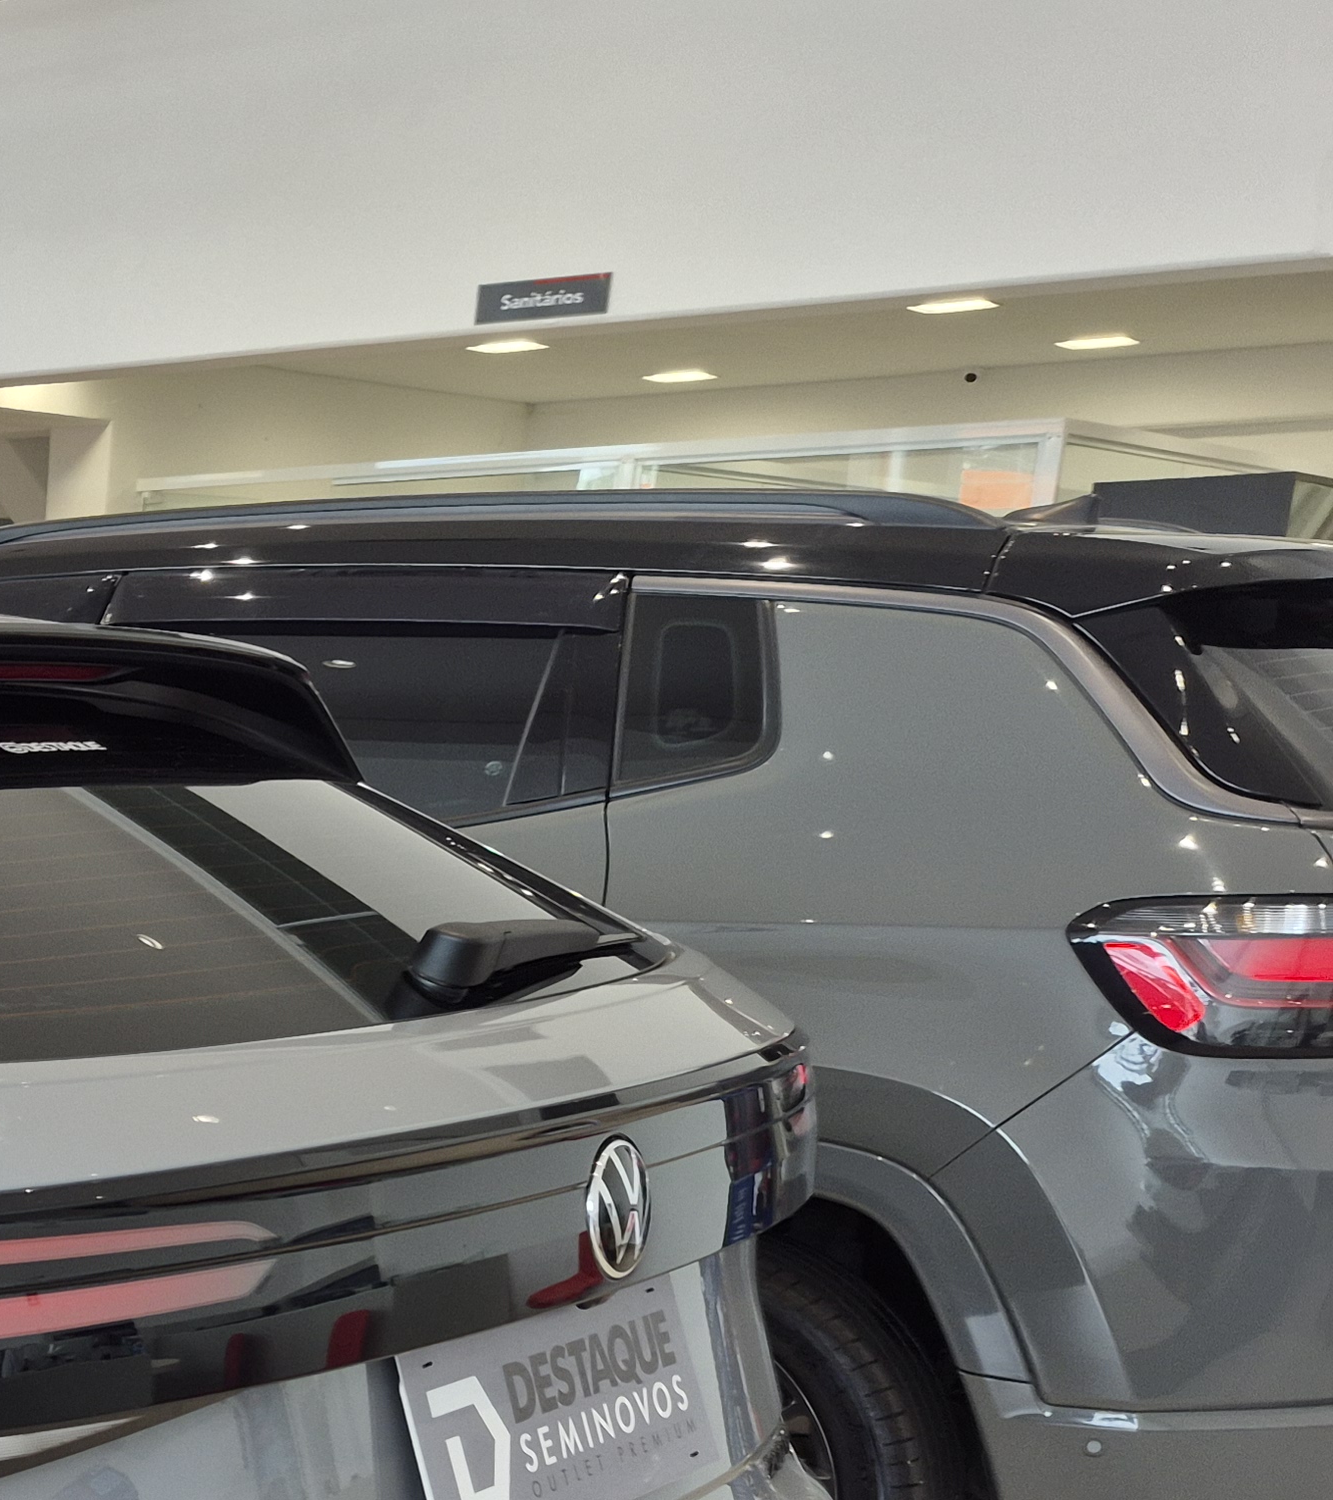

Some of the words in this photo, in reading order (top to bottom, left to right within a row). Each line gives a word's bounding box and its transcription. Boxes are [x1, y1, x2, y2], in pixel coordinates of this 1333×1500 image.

[500, 289, 584, 310] Sanitários
[502, 1310, 677, 1424] DESTAQUE
[519, 1374, 689, 1473] SEMINOVOS
[532, 1455, 604, 1498] OUTLET
[617, 1421, 697, 1463] PREMIUM
